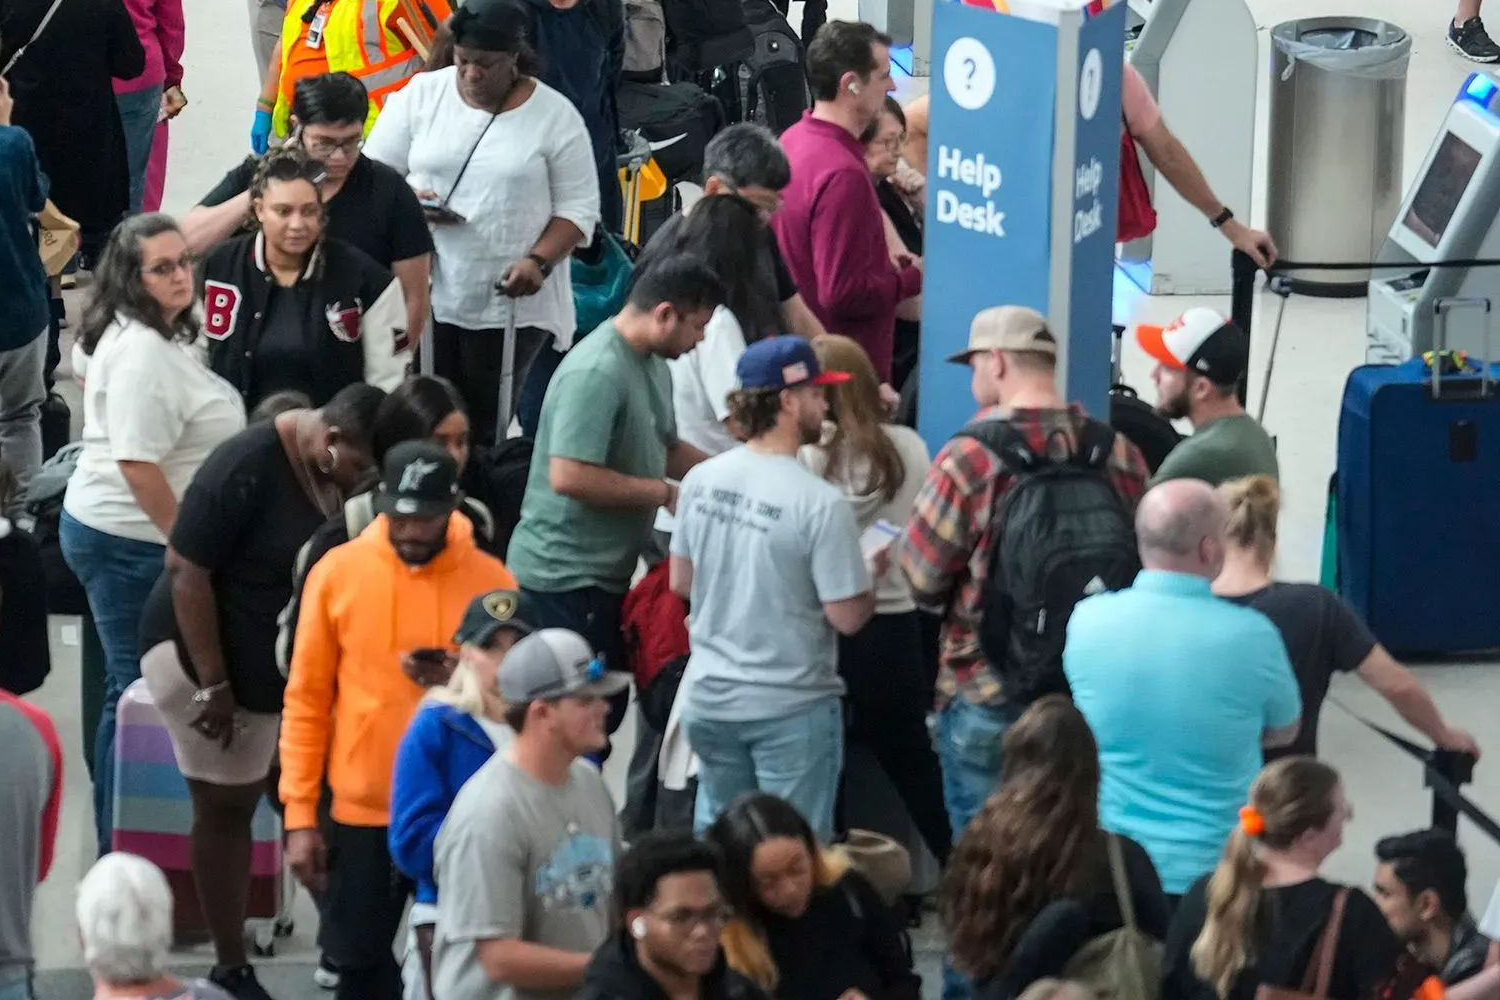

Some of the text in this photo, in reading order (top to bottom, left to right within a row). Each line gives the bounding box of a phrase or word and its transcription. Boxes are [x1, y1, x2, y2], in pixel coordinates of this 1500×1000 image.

[938, 144, 1002, 198] Help
[1075, 154, 1103, 199] Help
[936, 189, 1006, 237] Desk
[1073, 198, 1103, 243] Desk
[205, 279, 242, 341] B
